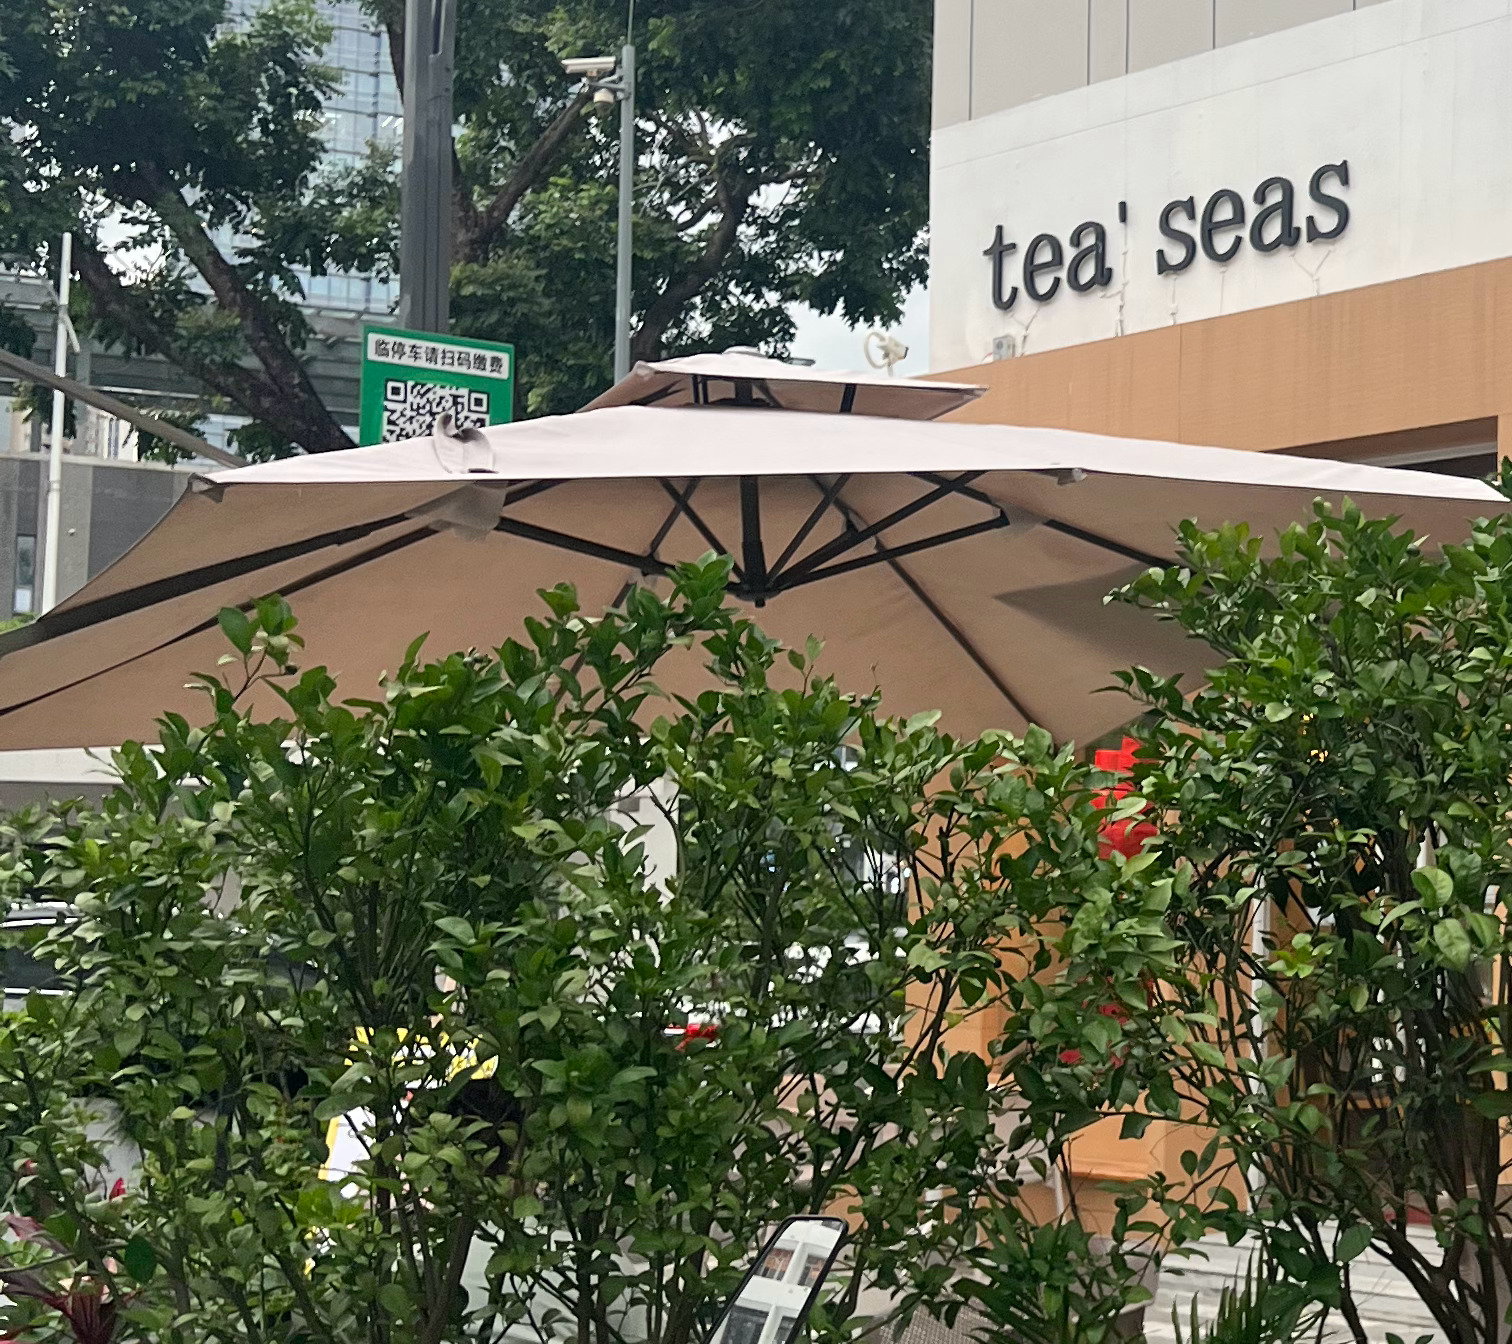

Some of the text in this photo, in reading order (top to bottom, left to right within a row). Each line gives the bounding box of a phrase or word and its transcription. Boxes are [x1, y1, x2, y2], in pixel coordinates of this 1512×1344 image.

[1155, 159, 1351, 275] seas
[374, 338, 504, 375] 临停车请扫码缴费
